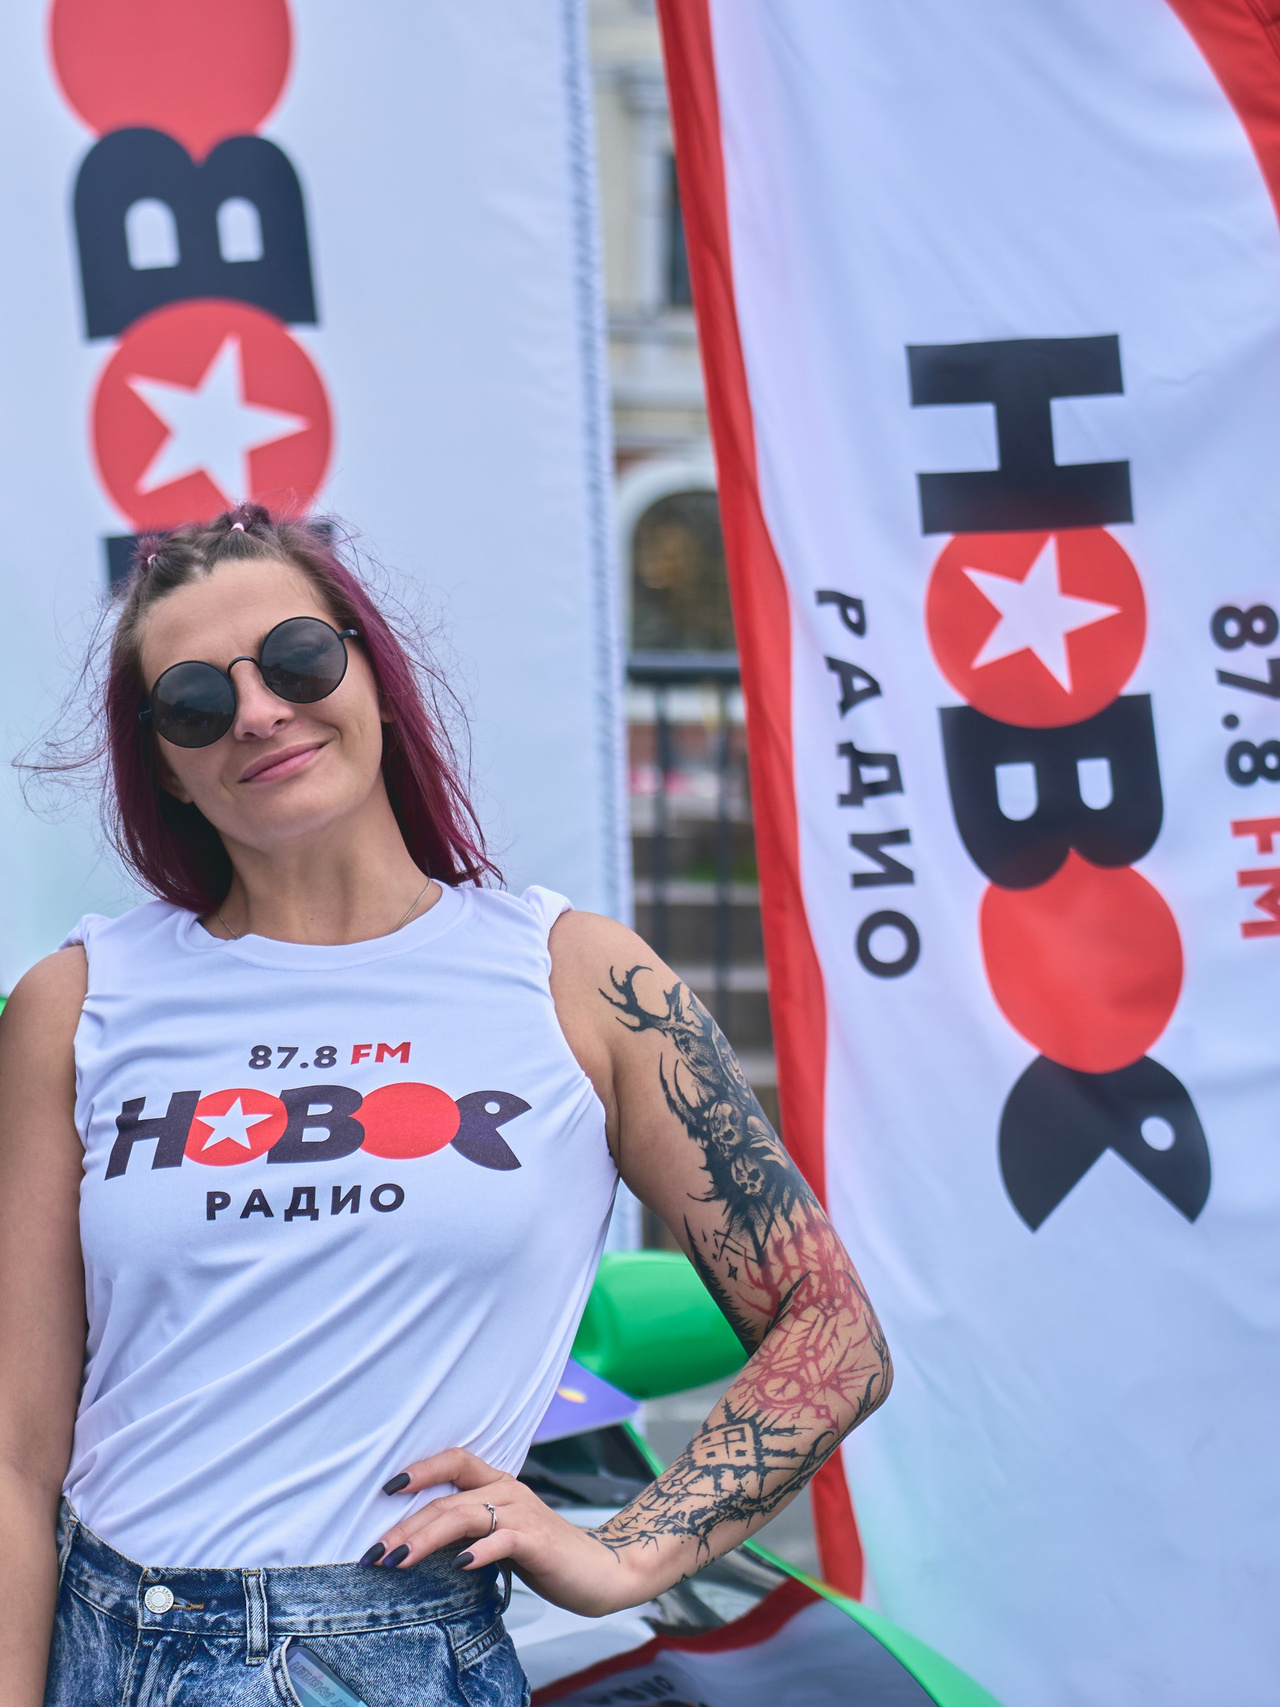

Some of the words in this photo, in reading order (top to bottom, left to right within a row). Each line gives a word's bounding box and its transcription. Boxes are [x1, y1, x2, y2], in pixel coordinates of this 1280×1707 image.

[47, 0, 335, 594] ОВО
[1210, 604, 1280, 786] 87.8
[815, 589, 921, 980] РАДИО
[1230, 815, 1280, 940] FM
[248, 1044, 338, 1070] 87.8
[350, 1041, 411, 1065] FM
[206, 1183, 405, 1222] РАДИО
